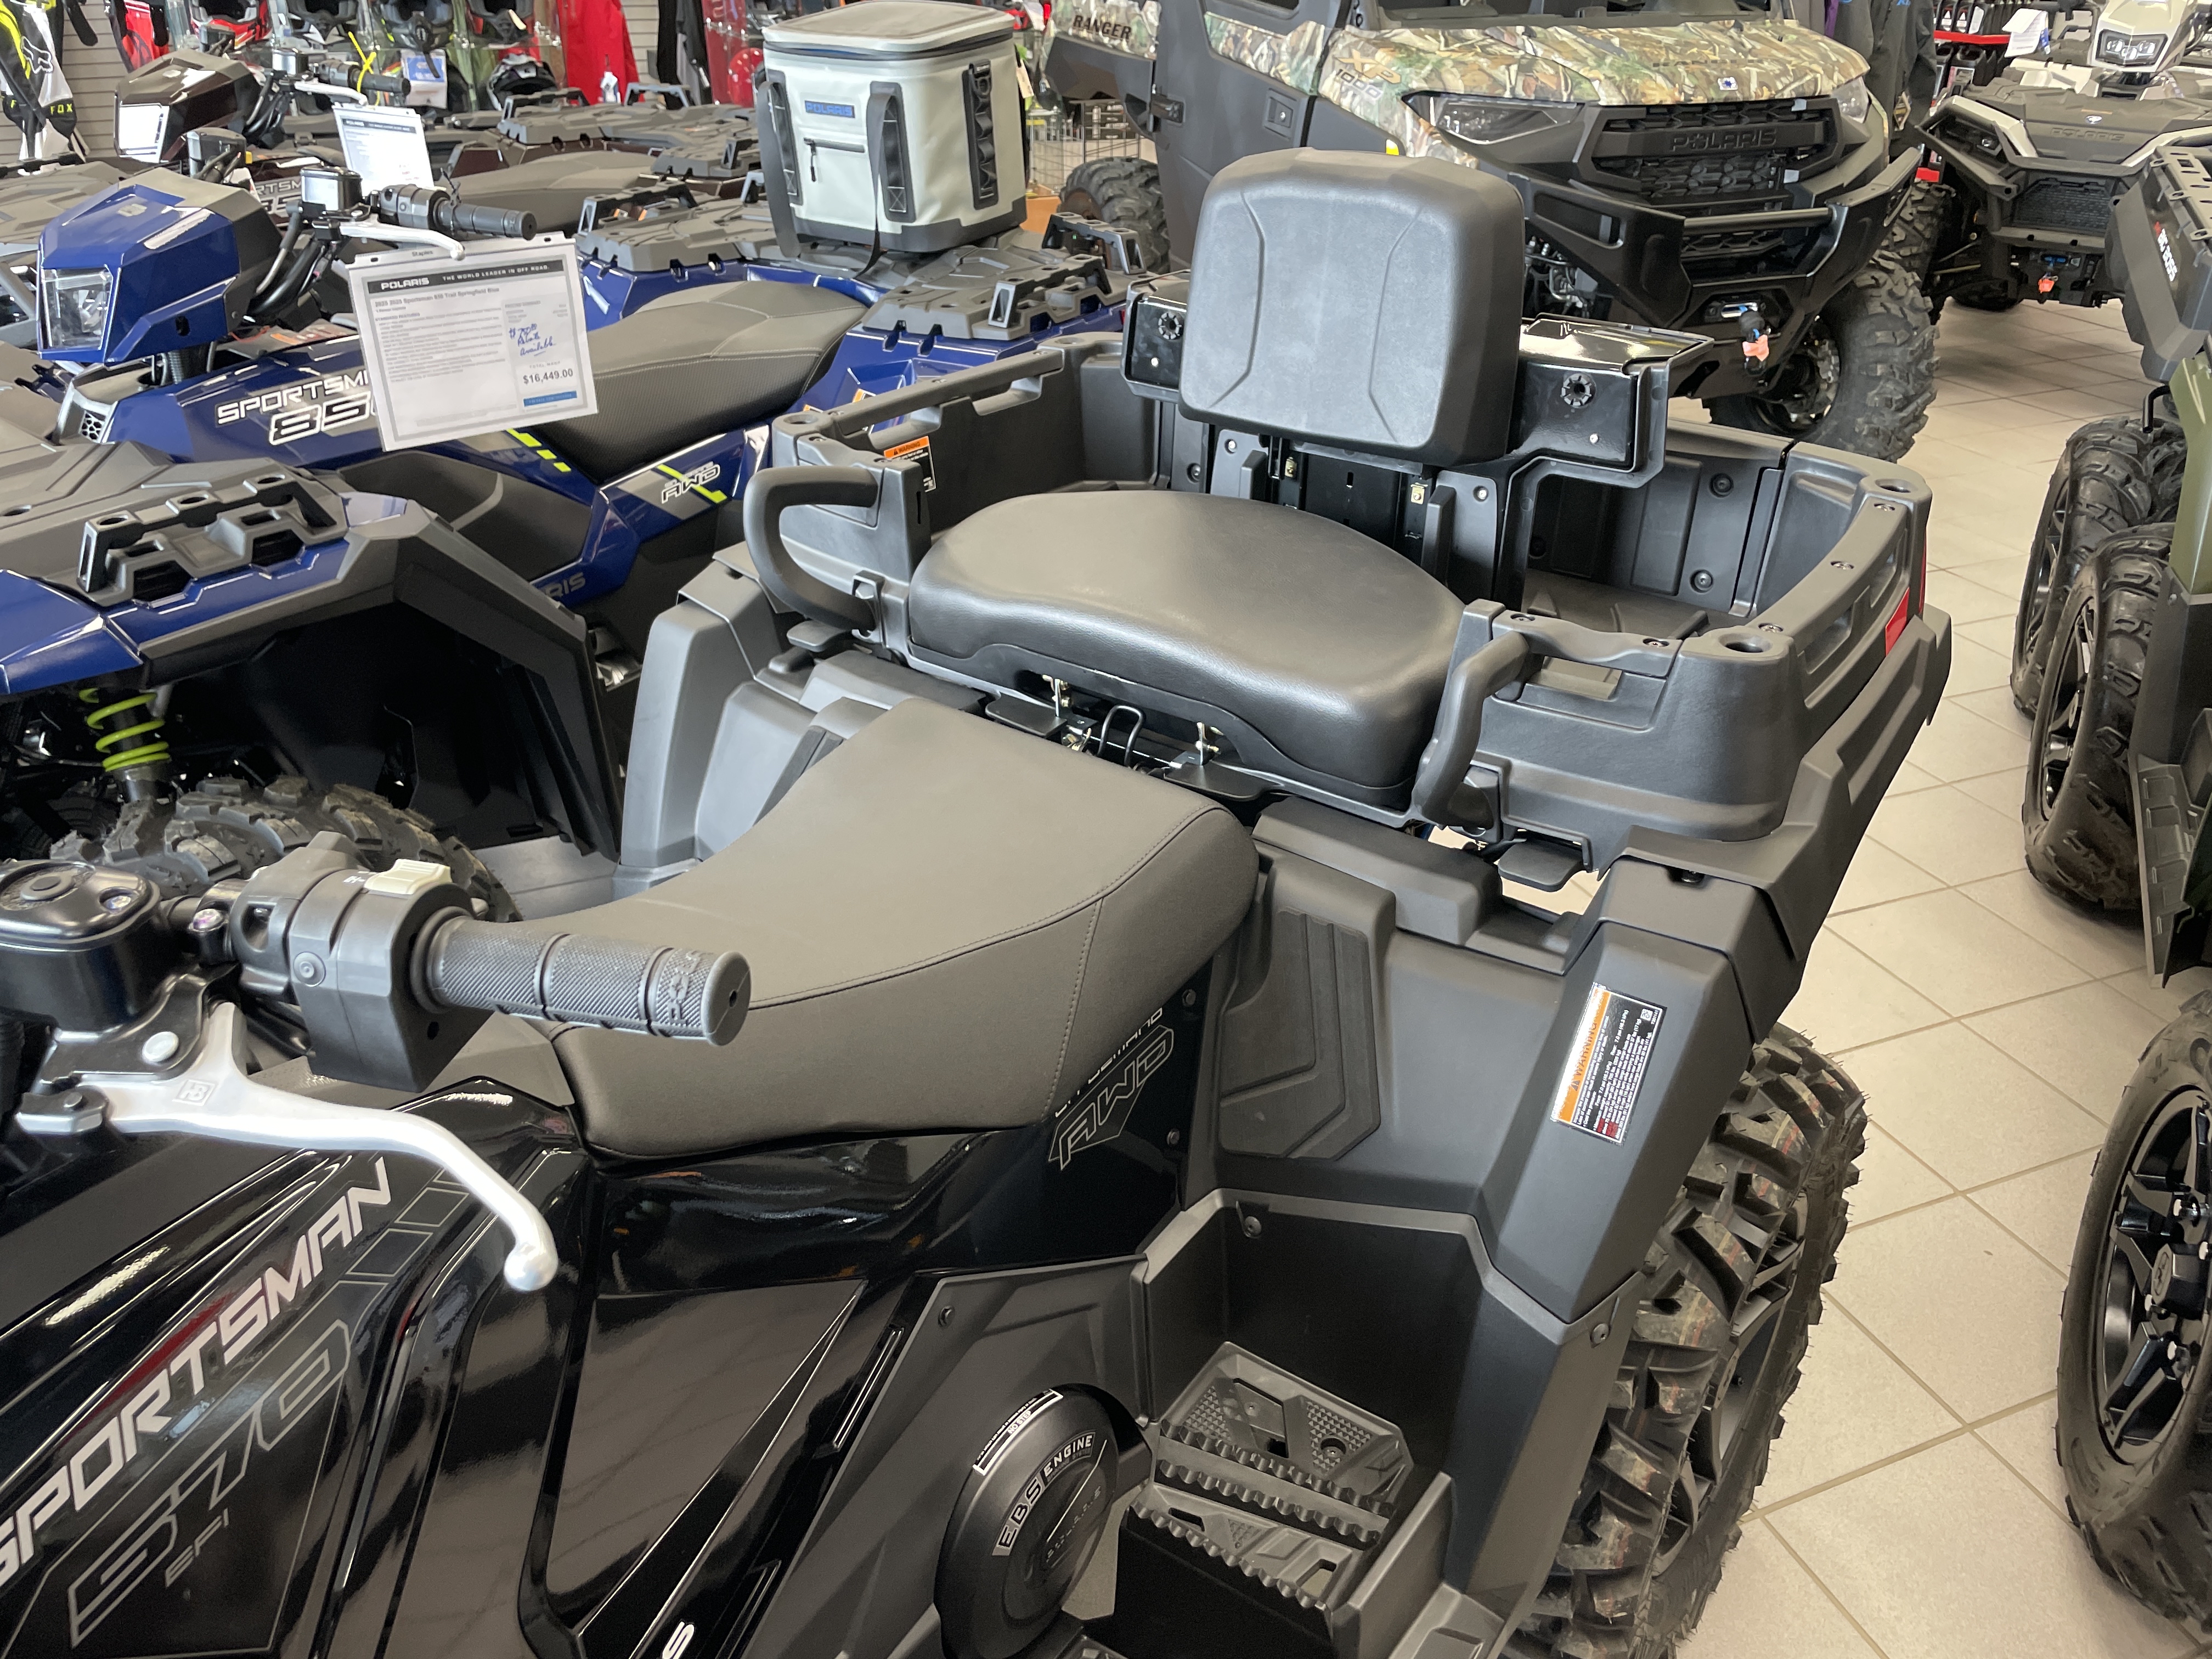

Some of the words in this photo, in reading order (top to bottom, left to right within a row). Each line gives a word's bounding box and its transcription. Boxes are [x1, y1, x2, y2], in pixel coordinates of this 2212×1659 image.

[1073, 15, 1132, 39] RANGER
[1335, 49, 1401, 84] XP
[1336, 69, 1383, 98] 1000
[50, 104, 72, 115] FOX
[806, 103, 852, 116] POLARIS
[1671, 129, 1777, 152] POLARIS
[381, 278, 429, 290] POLARIS
[523, 368, 573, 385] $16,449.00
[218, 370, 368, 425] SPORTSM
[269, 391, 376, 445] 85
[898, 441, 921, 453] WARNING
[661, 464, 720, 504] AWD
[1059, 1028, 1173, 1170] AWD
[1007, 1423, 1018, 1434] NO
[1017, 1410, 1031, 1425] STEP
[67, 1319, 351, 1648] 570
[998, 1478, 1042, 1549] EBS
[1044, 1435, 1092, 1477] ENGINE
[165, 1508, 230, 1588] EFI
